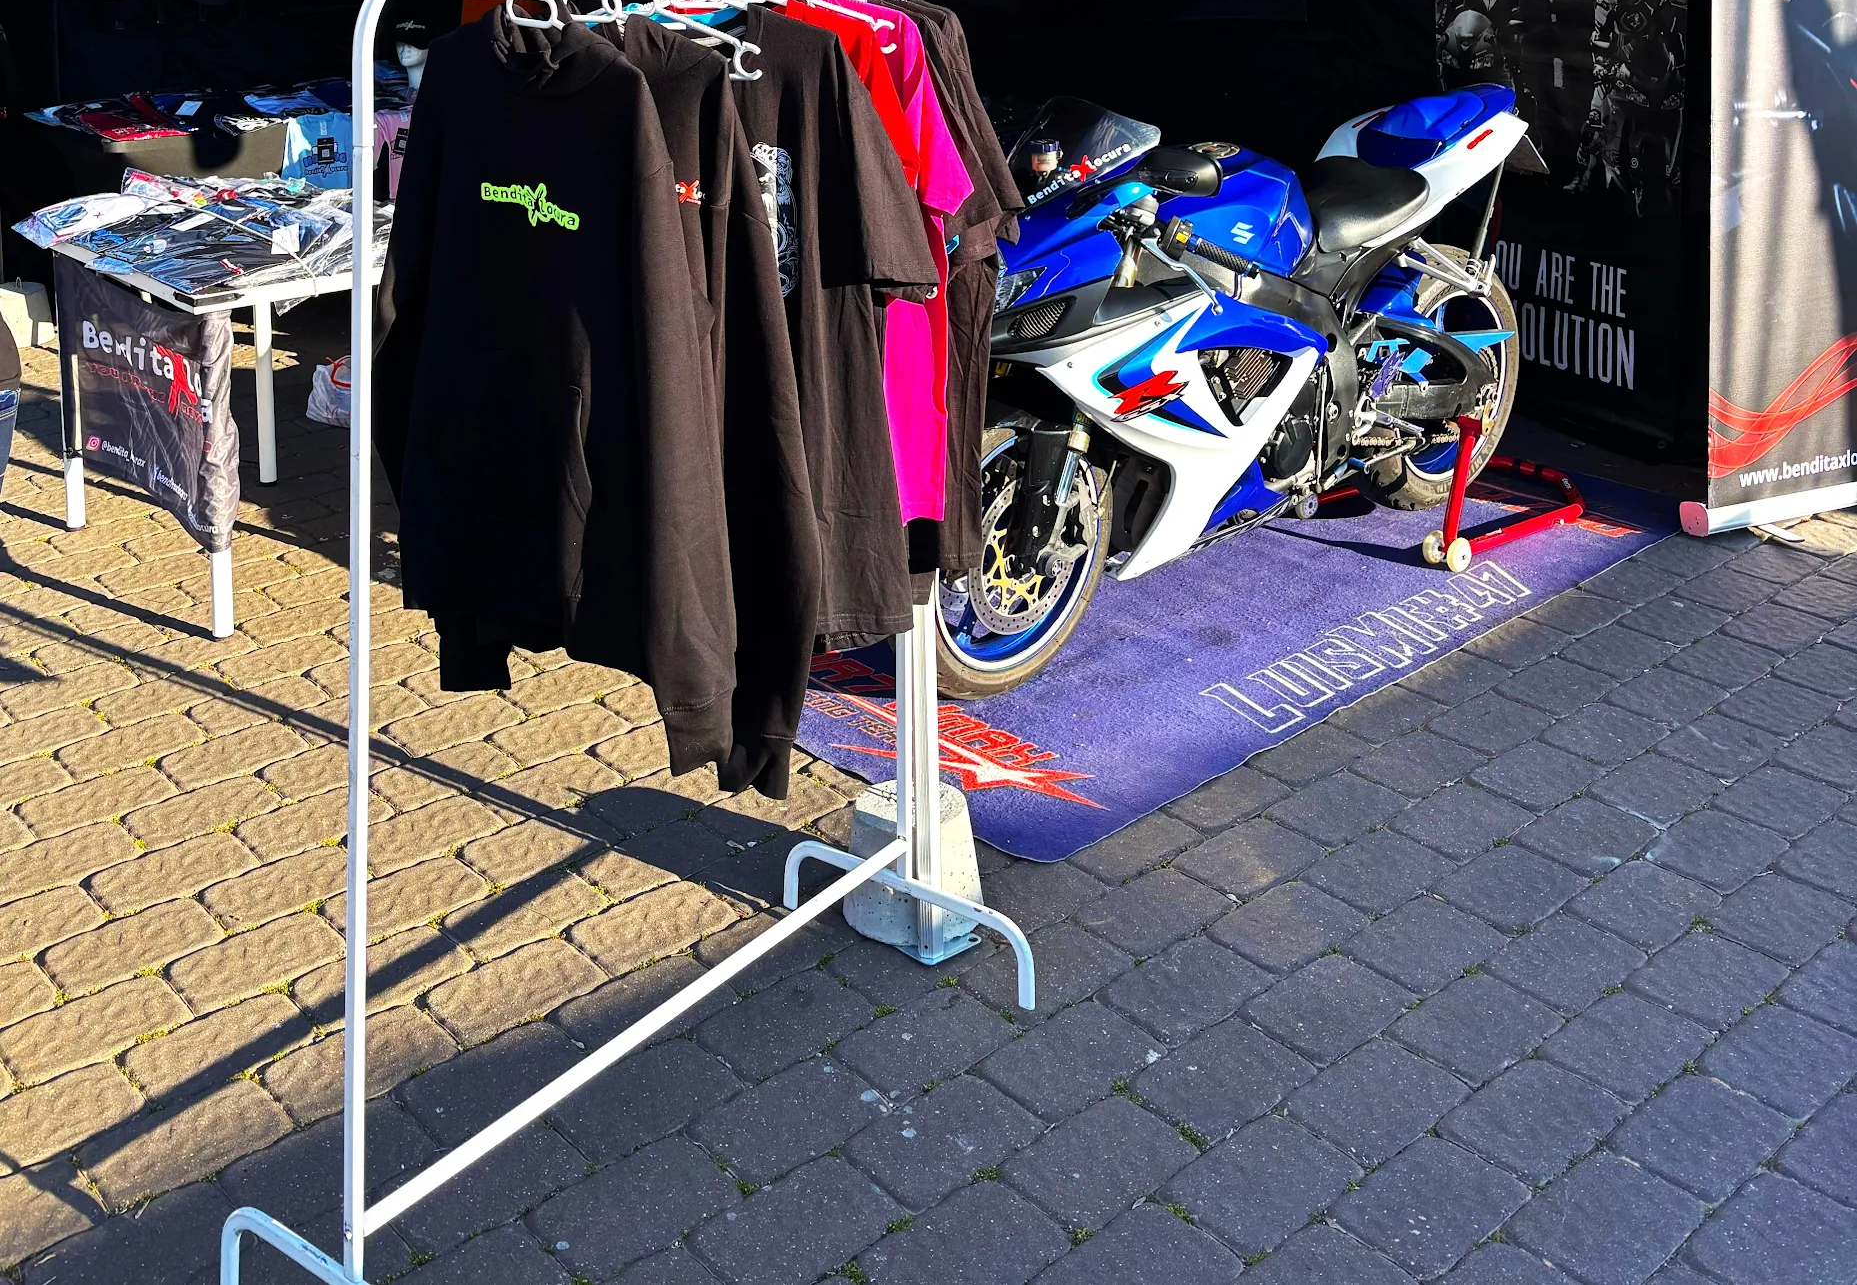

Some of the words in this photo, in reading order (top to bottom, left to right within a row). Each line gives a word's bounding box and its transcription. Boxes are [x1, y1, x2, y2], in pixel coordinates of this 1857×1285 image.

[484, 186, 533, 207] Bendita
[1027, 170, 1081, 204] Bendita
[1085, 143, 1131, 169] locura
[1495, 240, 1522, 290] OU
[1535, 249, 1575, 305] ARE
[1590, 261, 1627, 319] THE
[1513, 299, 1635, 391] OLUTION
[1739, 450, 1857, 488] www.benditaxlo
